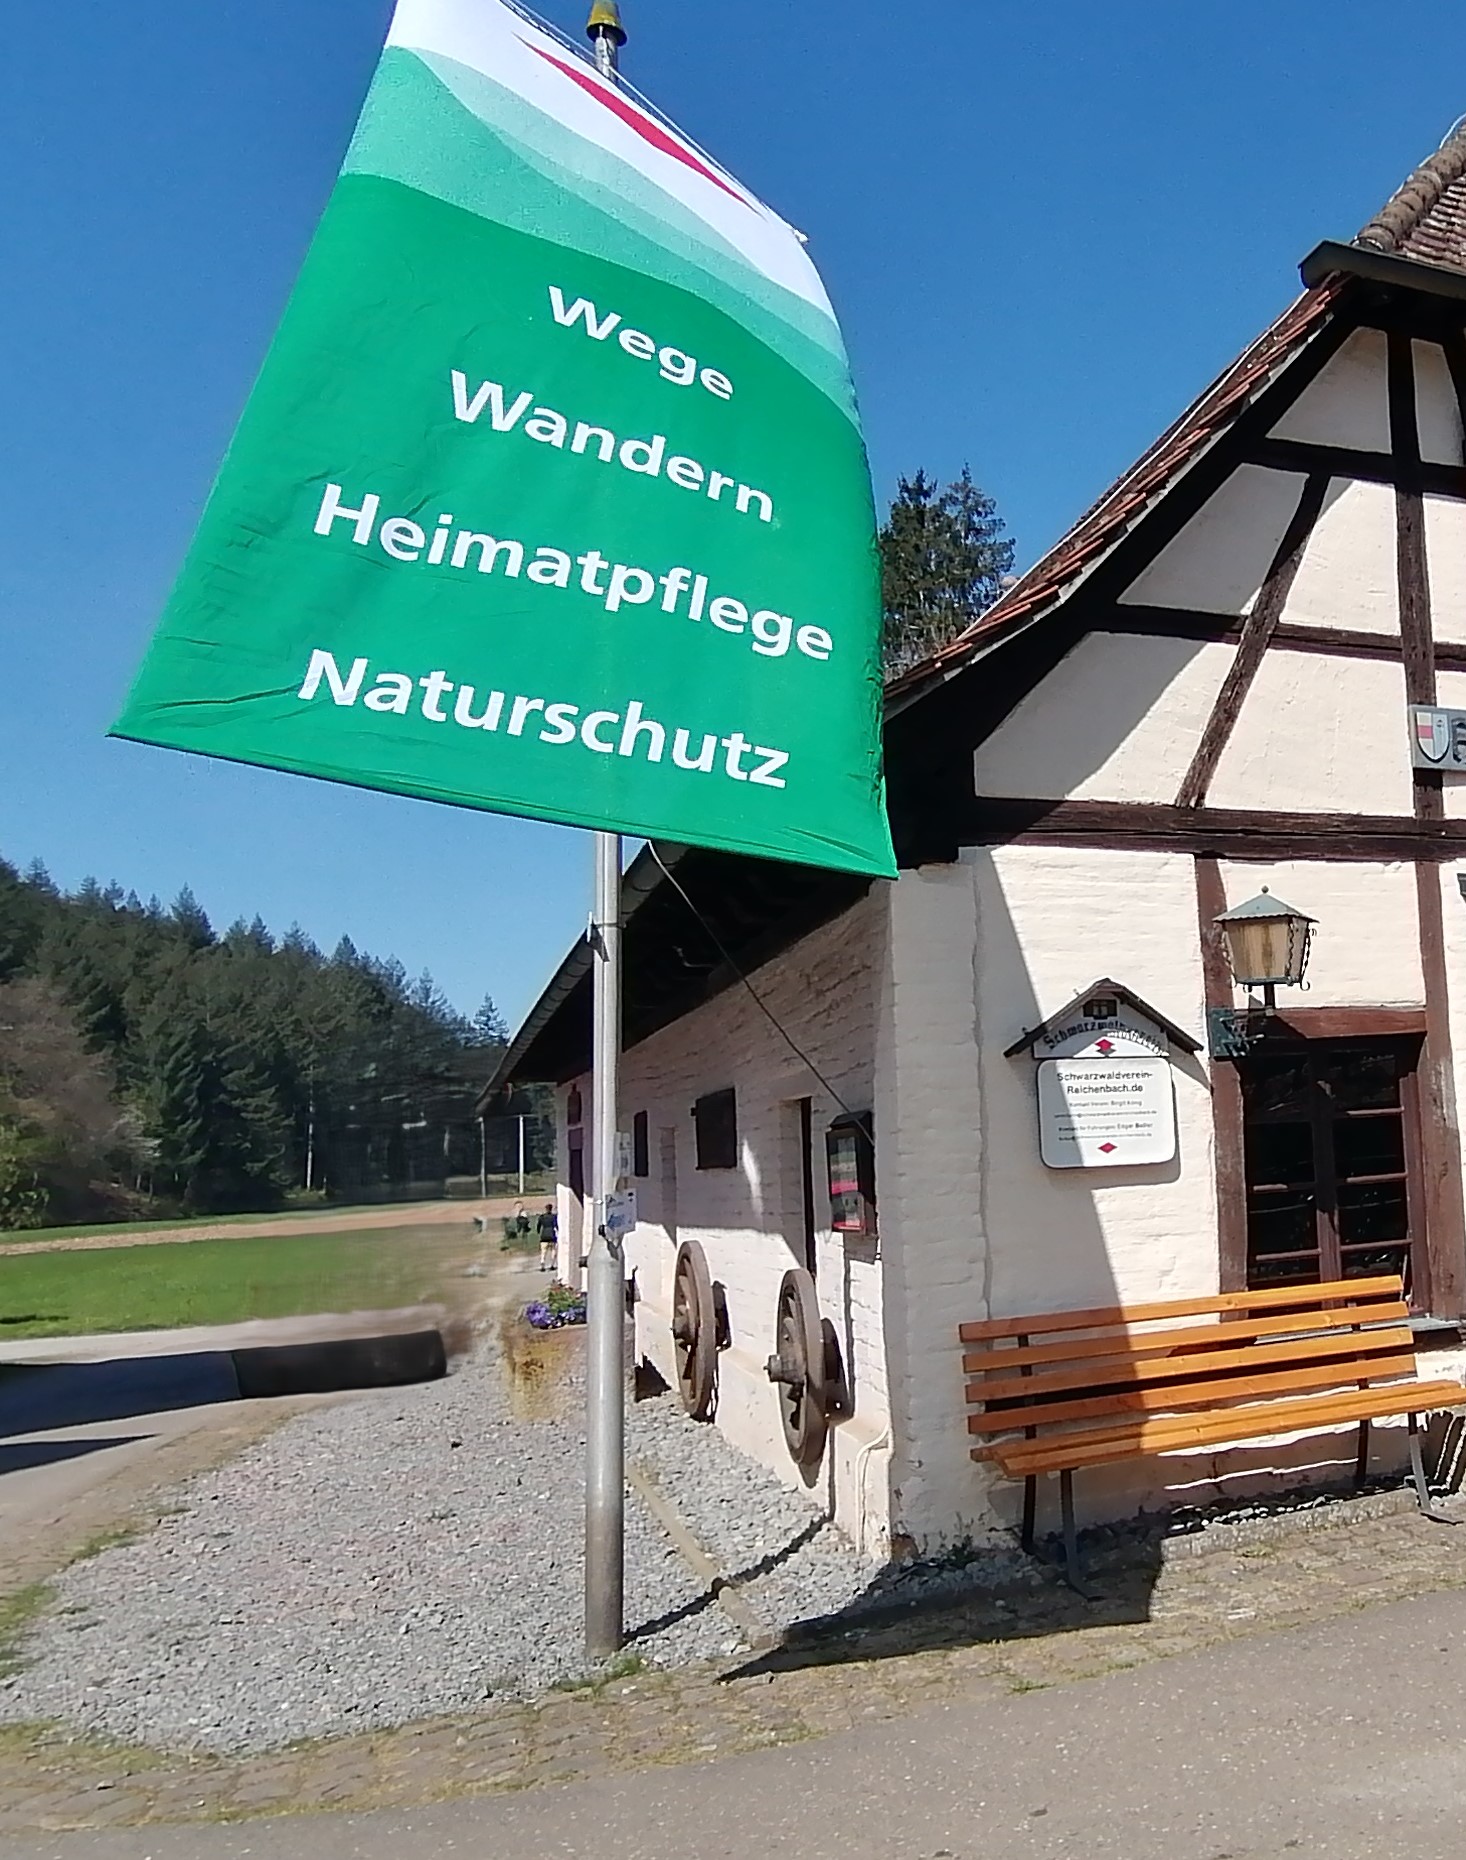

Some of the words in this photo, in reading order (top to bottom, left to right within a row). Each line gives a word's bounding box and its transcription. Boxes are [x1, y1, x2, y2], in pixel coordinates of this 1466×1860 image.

[548, 285, 734, 400] Wege
[450, 369, 774, 523] Wandern
[313, 483, 834, 661] Heimatpflege
[297, 648, 790, 789] Naturschutz
[1057, 1071, 1153, 1081] Schwarzwaldverein-
[1067, 1084, 1144, 1094] Reichenbach.de
